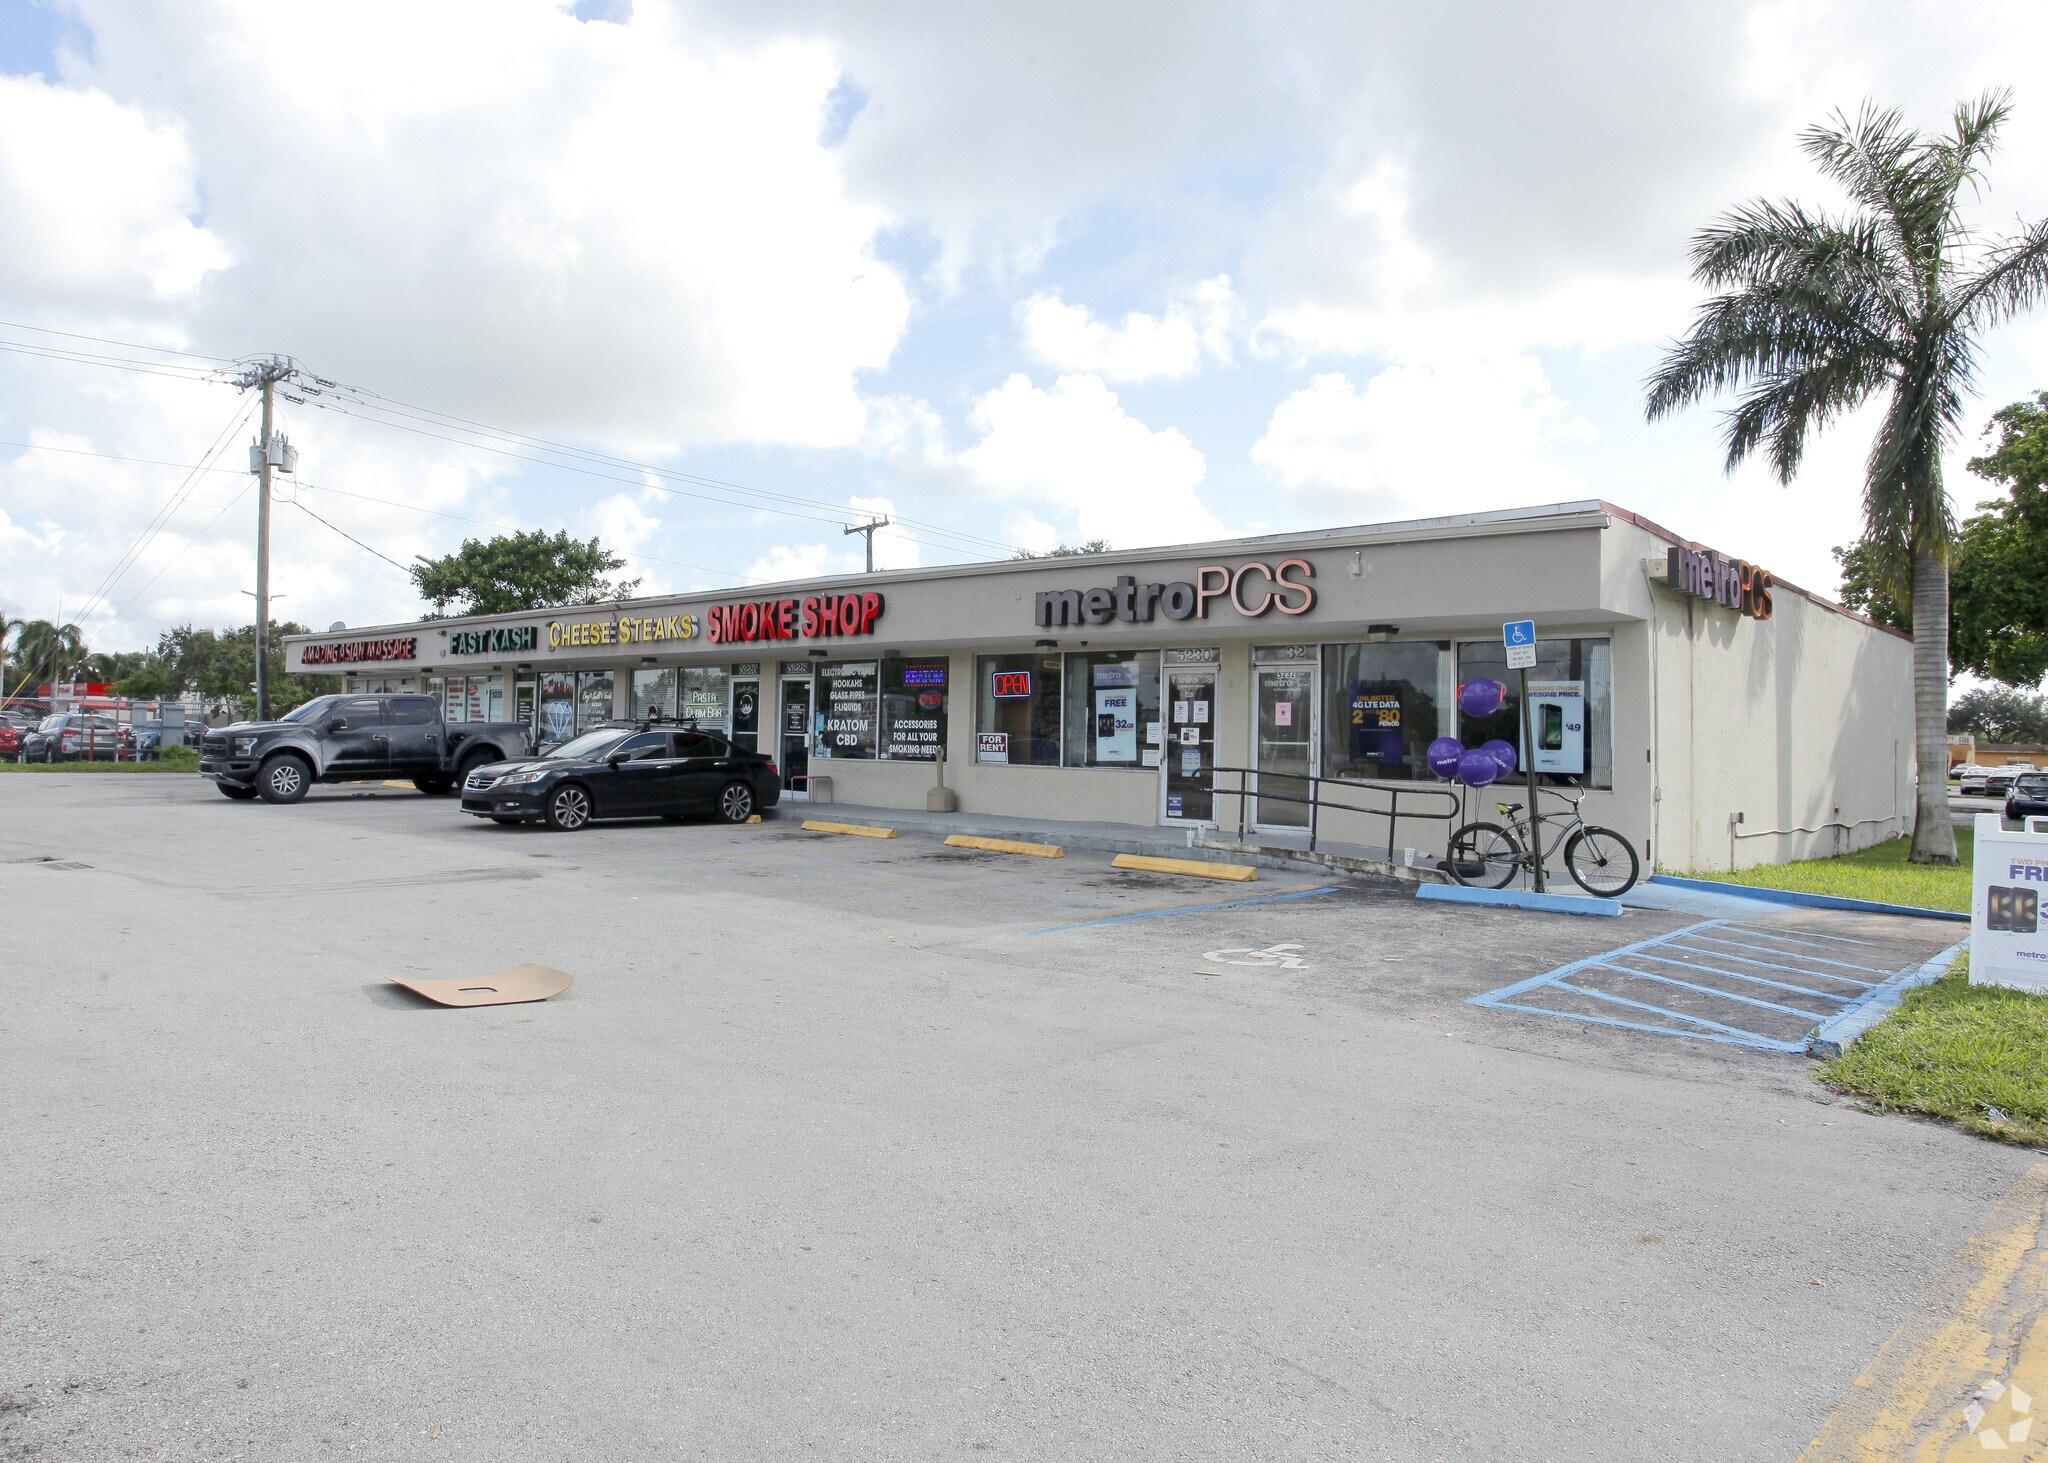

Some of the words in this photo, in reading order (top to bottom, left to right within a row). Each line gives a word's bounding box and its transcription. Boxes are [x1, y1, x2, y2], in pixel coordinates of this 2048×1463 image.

[1675, 548, 1773, 620] metroPCS
[1035, 558, 1318, 627] metroPCS
[707, 600, 799, 643] SMOKE
[802, 592, 885, 638] SHOP
[450, 630, 488, 654] FAST
[490, 626, 537, 651] KASH
[302, 643, 338, 664] AMAZING
[340, 640, 365, 662] ASIAN
[367, 637, 417, 660] MASSAGE
[1177, 648, 1212, 661] 5230
[1287, 645, 1306, 659] 32
[832, 679, 863, 688] HOOKAHS
[995, 674, 1029, 695] OPEN
[692, 691, 717, 703] PASTA
[830, 691, 848, 700] GLASS
[849, 691, 865, 699] PIPES
[1105, 699, 1127, 707] FREE
[1352, 709, 1364, 724] 2
[827, 719, 868, 731] KRATOM
[894, 720, 938, 729] ACCESSORIES
[836, 734, 858, 746] CBD
[893, 732, 906, 741] FOR
[907, 732, 918, 741] ALL
[920, 732, 938, 741] YOUR
[982, 735, 1002, 743] FOR
[888, 744, 920, 754] SMOKING
[980, 743, 1005, 752] RENT
[1436, 757, 1457, 766] metro
[2016, 951, 2048, 959] metro
